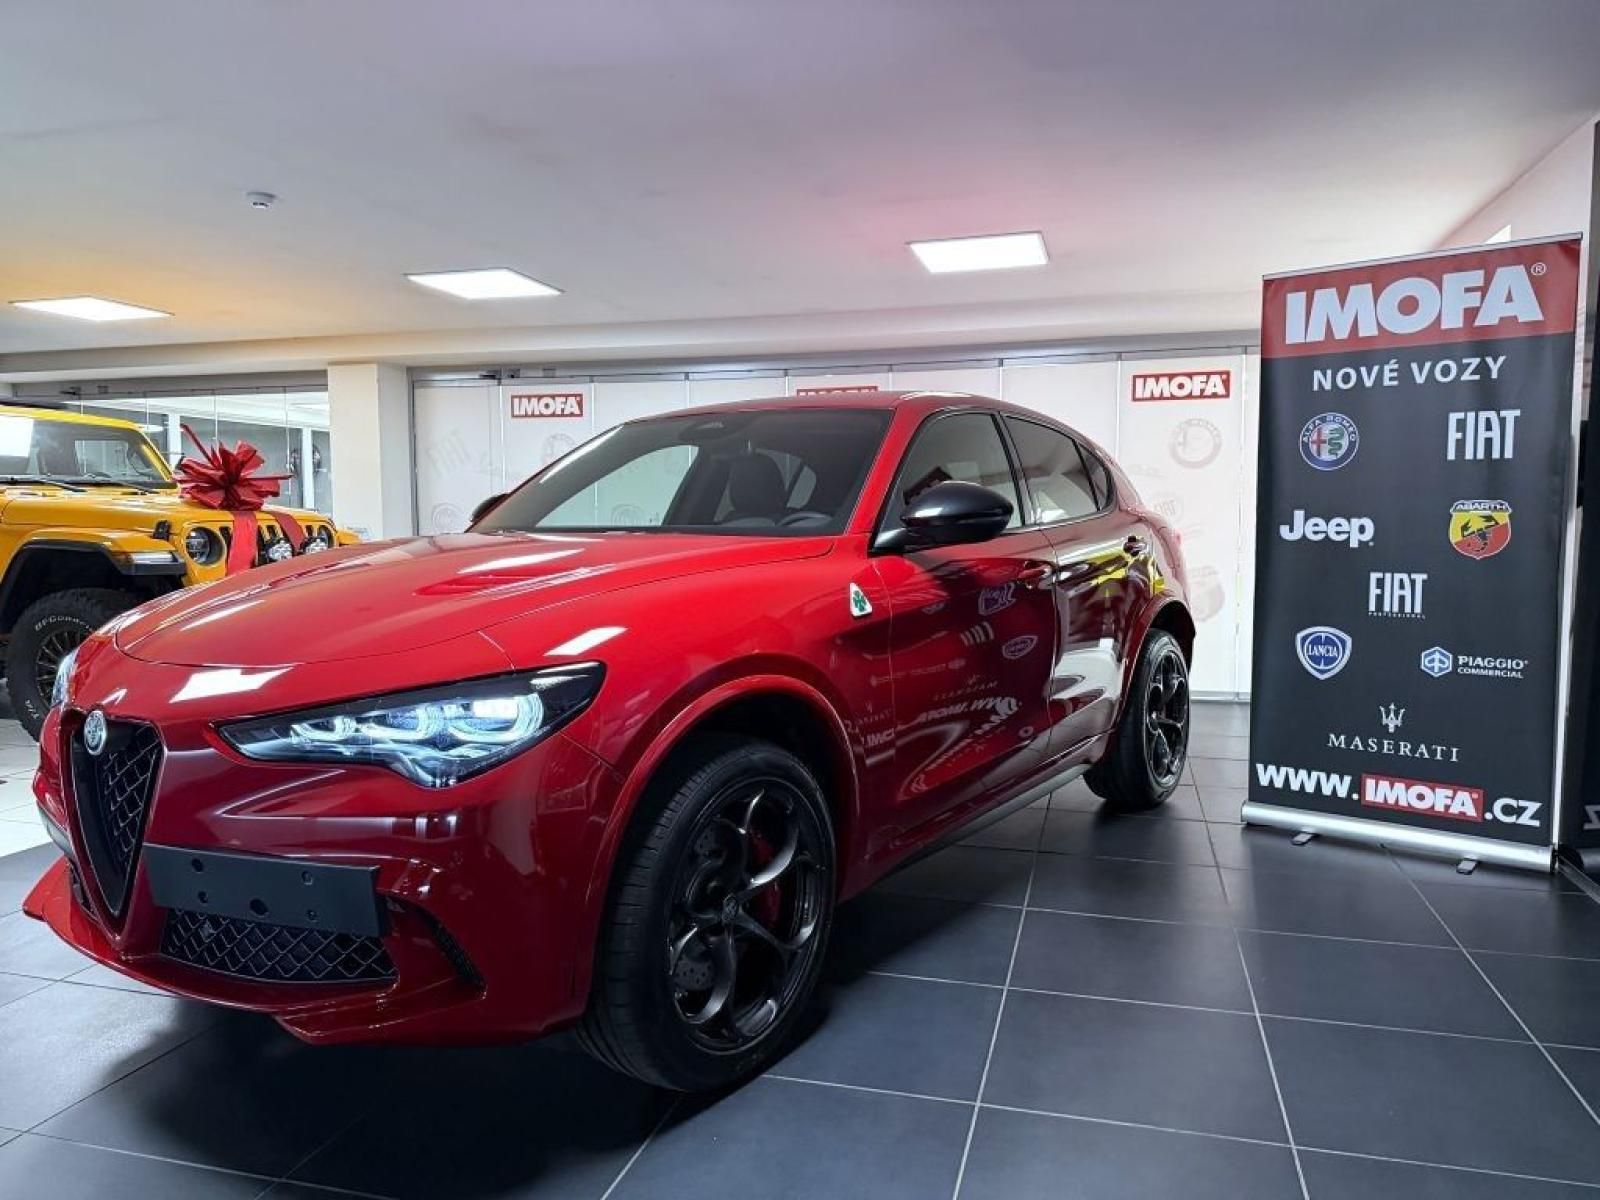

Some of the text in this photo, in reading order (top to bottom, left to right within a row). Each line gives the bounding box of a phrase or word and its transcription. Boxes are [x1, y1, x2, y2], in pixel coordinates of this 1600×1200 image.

[1135, 374, 1228, 398] IMOFA
[1312, 355, 1507, 391] NOVÉ VOZY
[513, 397, 581, 417] IMOFA
[1447, 408, 1521, 460] FIAT
[1279, 509, 1375, 548] Jeep
[1368, 571, 1428, 614] FIAT
[1308, 643, 1338, 658] LANCIA
[1457, 666, 1524, 679] COMMERCIAL
[1326, 733, 1460, 762] MASERATI
